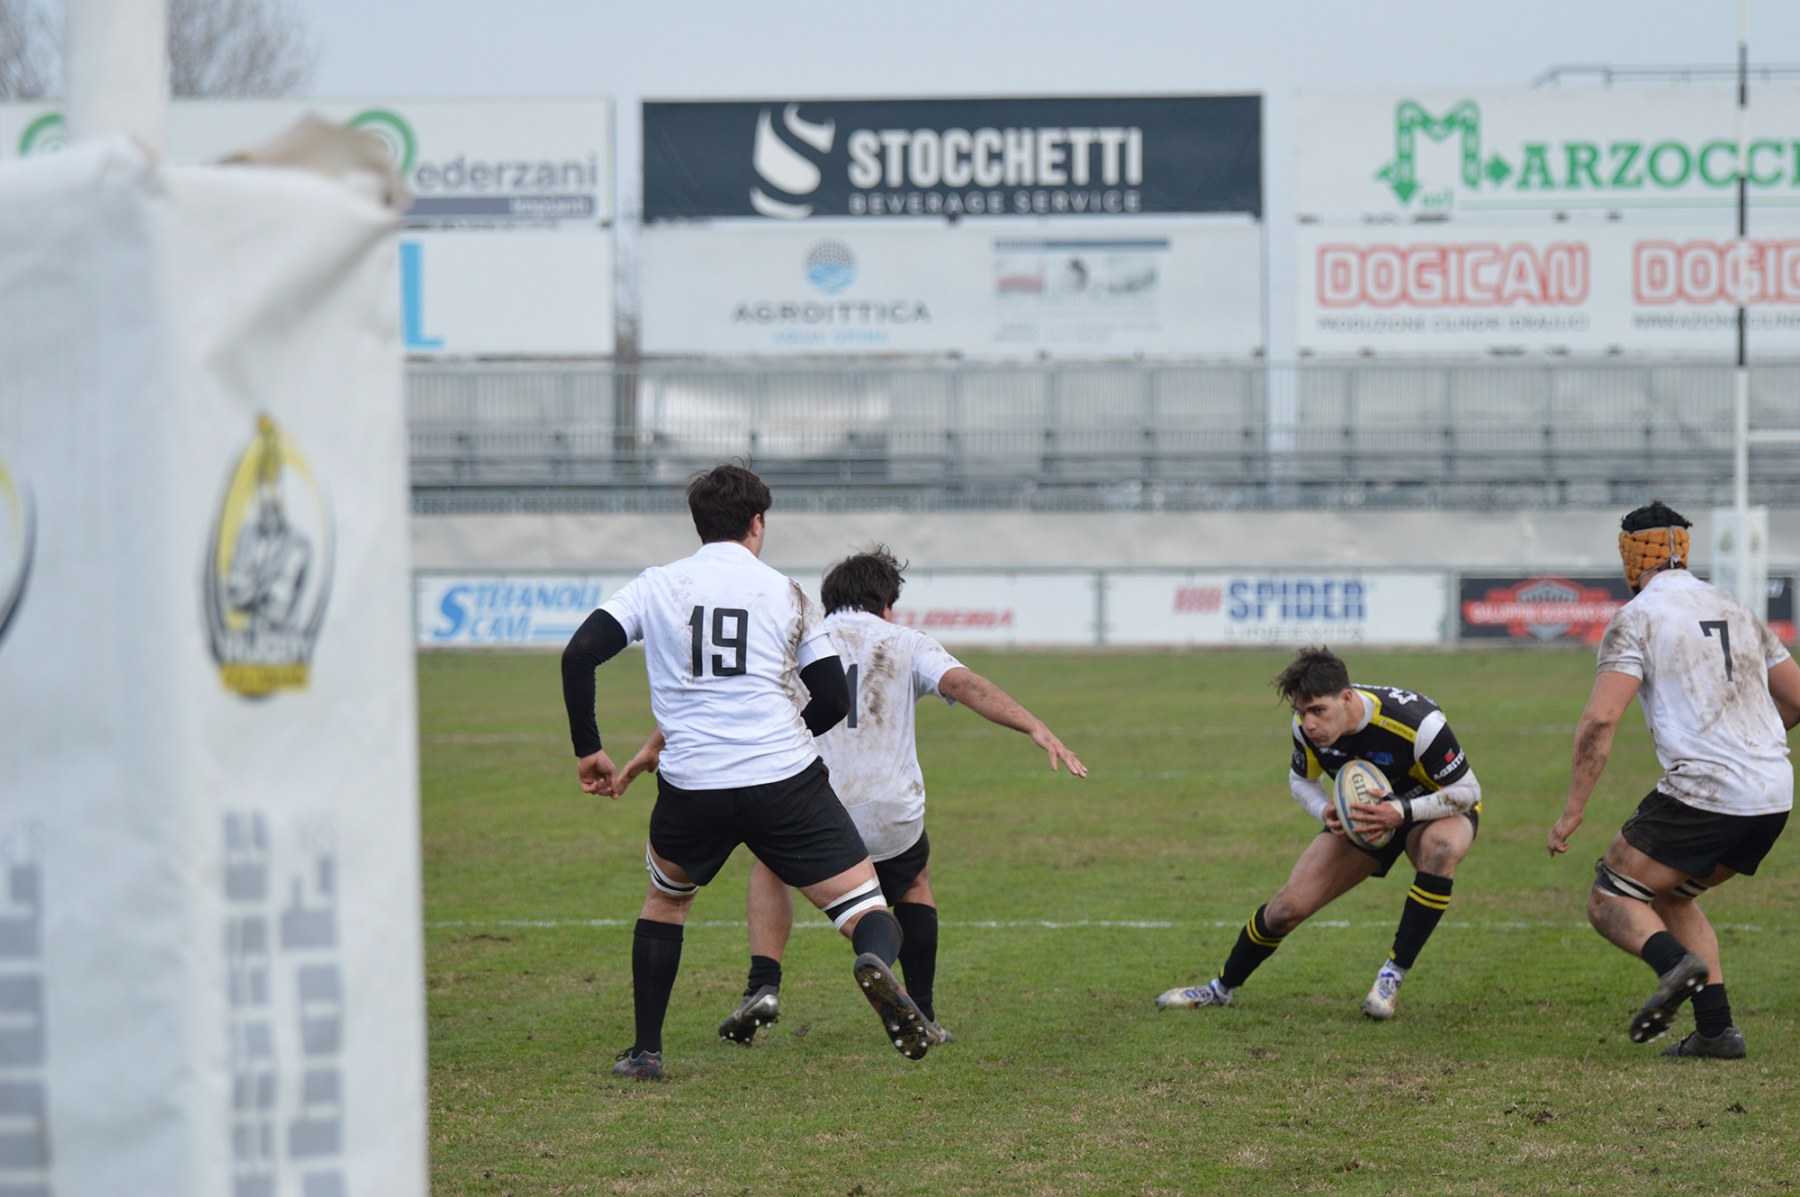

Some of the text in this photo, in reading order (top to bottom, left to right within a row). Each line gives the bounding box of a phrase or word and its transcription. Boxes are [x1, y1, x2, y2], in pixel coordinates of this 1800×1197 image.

[847, 126, 1143, 189] STOCCHETTI
[848, 189, 1143, 216] BEVERAGE SERVICE
[1316, 241, 1591, 308] DOGICAN
[729, 298, 933, 326] AGROITTICA
[1227, 578, 1366, 622] SPIDER
[688, 604, 749, 677] 19
[1698, 620, 1733, 683] 7
[1351, 773, 1373, 805] GIL
